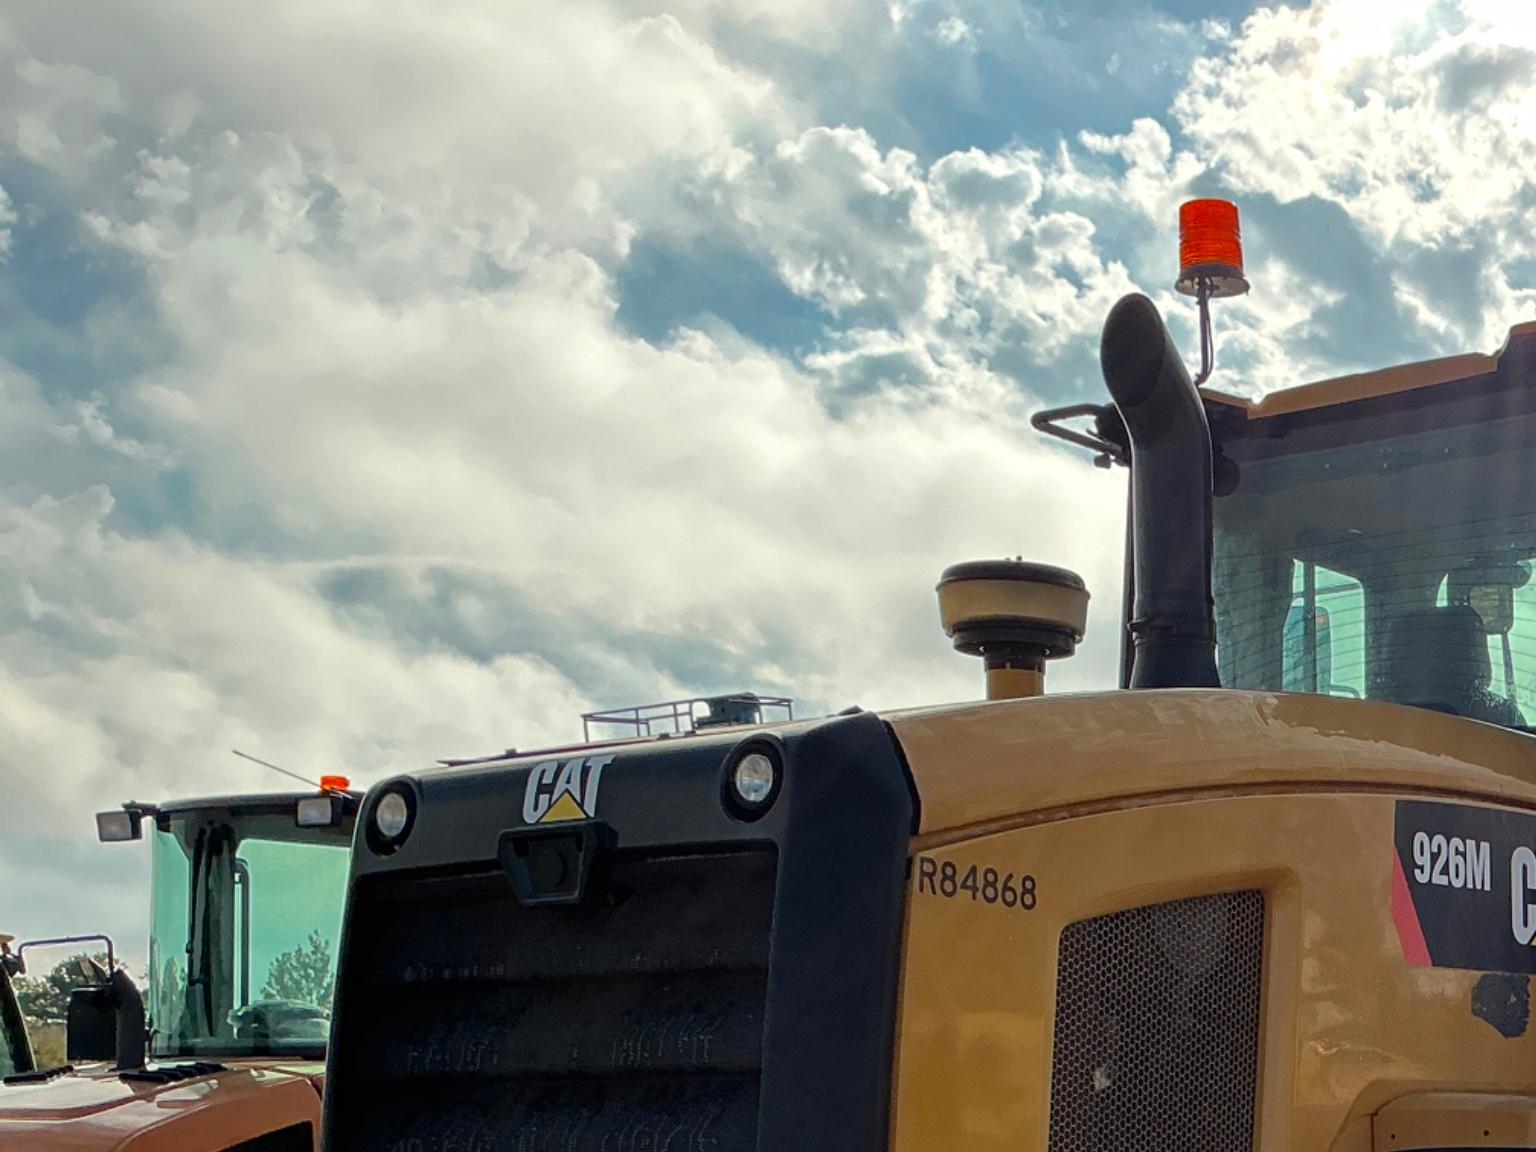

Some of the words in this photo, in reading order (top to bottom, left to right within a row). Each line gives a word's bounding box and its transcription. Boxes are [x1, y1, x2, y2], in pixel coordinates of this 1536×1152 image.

[523, 754, 616, 824] CAT
[919, 856, 1037, 911] R84868
[1413, 831, 1491, 891] 926M
